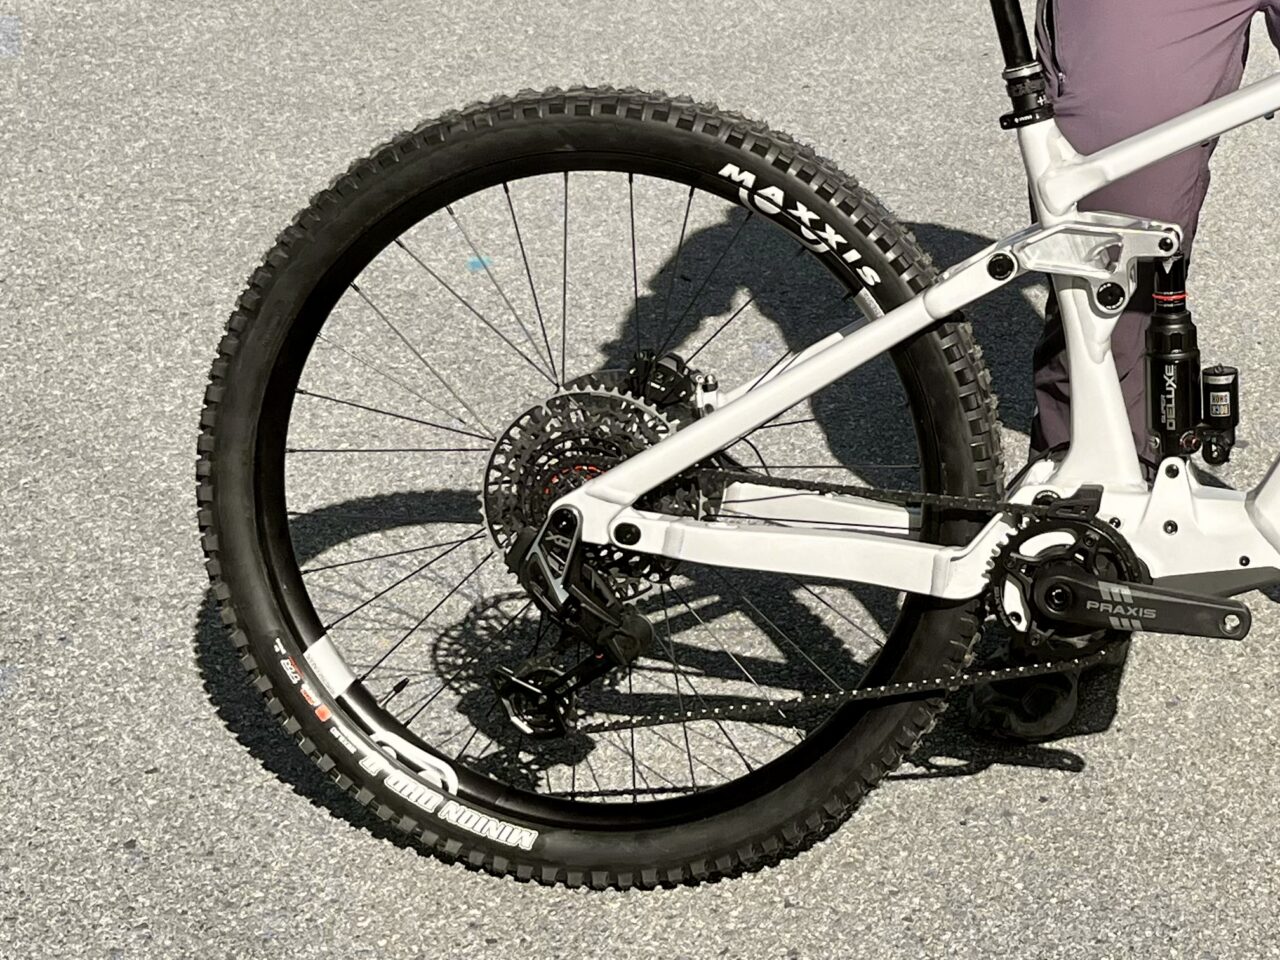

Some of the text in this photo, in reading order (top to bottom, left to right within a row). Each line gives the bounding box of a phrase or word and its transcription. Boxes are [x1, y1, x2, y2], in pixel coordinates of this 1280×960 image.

[718, 163, 881, 286] MAXXIS
[1163, 364, 1177, 430] DELUXE
[1086, 600, 1156, 619] PRAXIS
[438, 800, 538, 850] MINION
